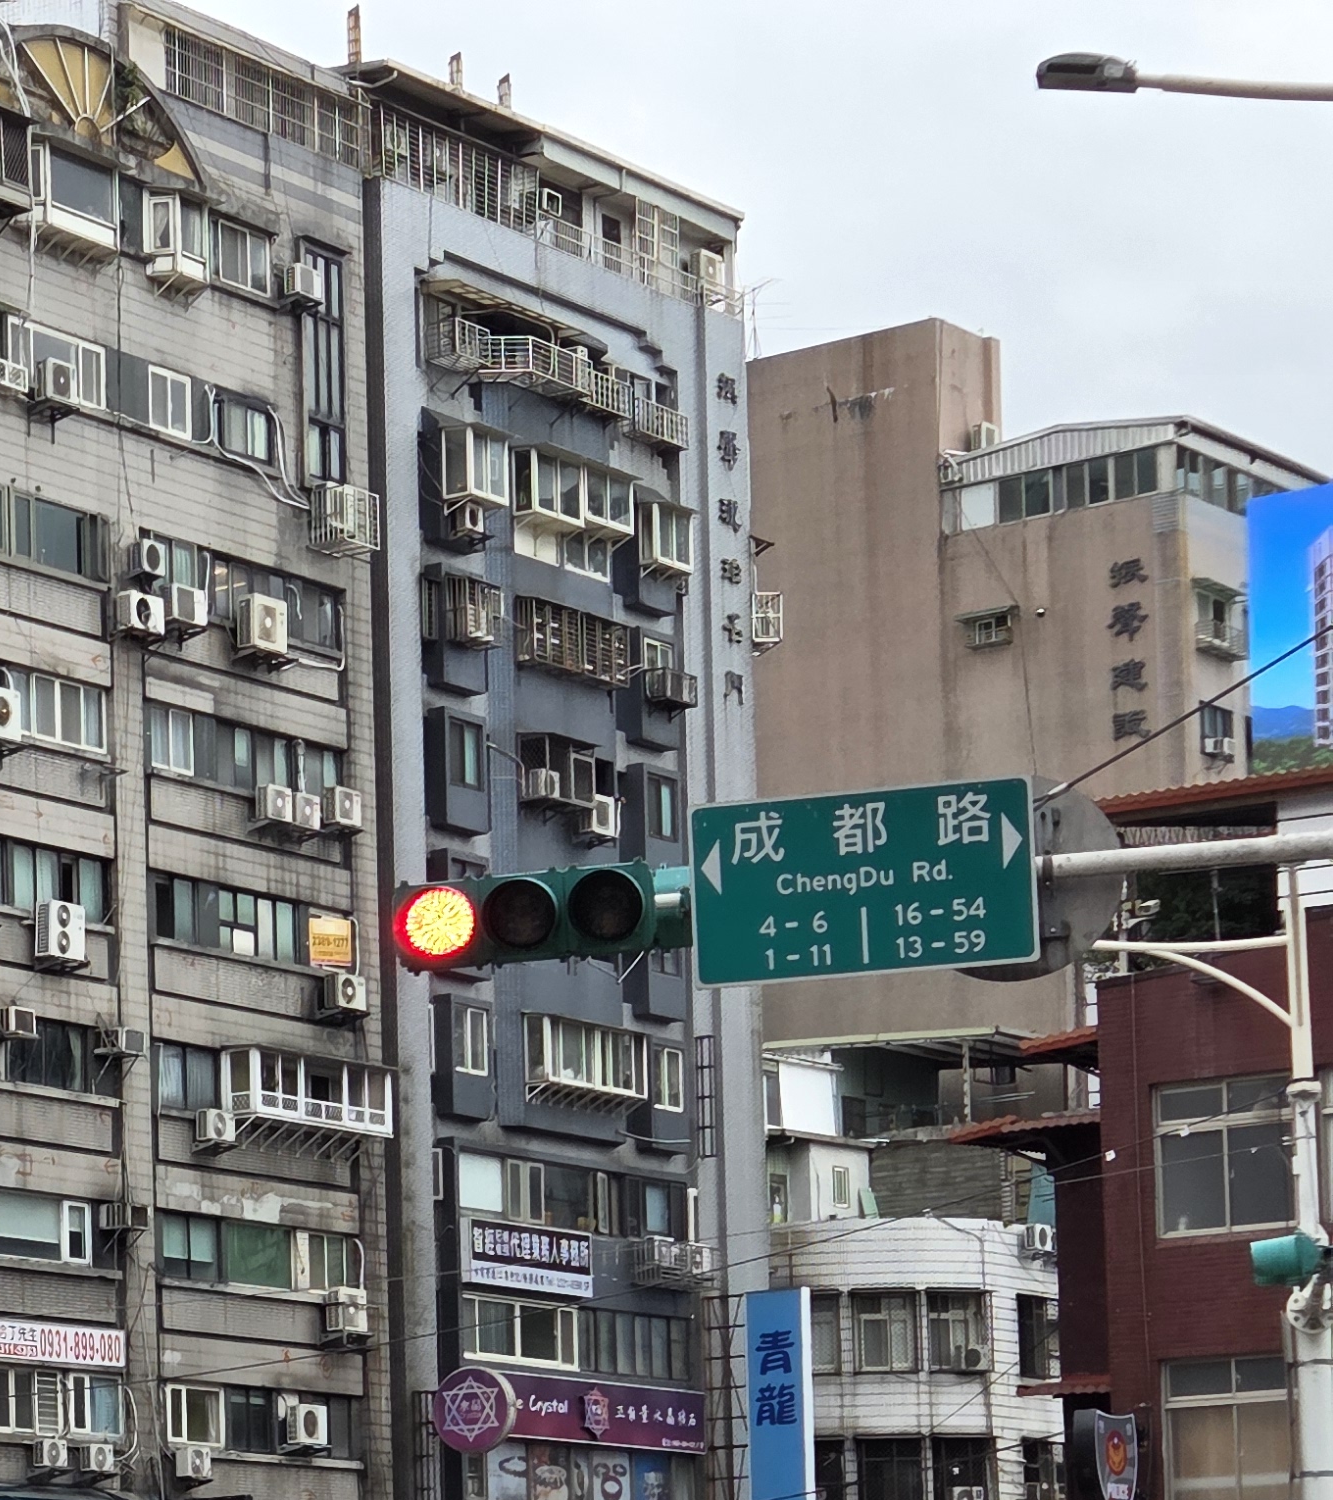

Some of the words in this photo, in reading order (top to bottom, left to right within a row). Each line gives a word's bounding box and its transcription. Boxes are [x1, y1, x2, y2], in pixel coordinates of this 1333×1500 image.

[730, 791, 992, 866] 成都路
[776, 864, 895, 897] ChengDu
[912, 857, 954, 881] Rd.
[529, 1393, 569, 1418] Crystal
[753, 1329, 799, 1428] 青龍
